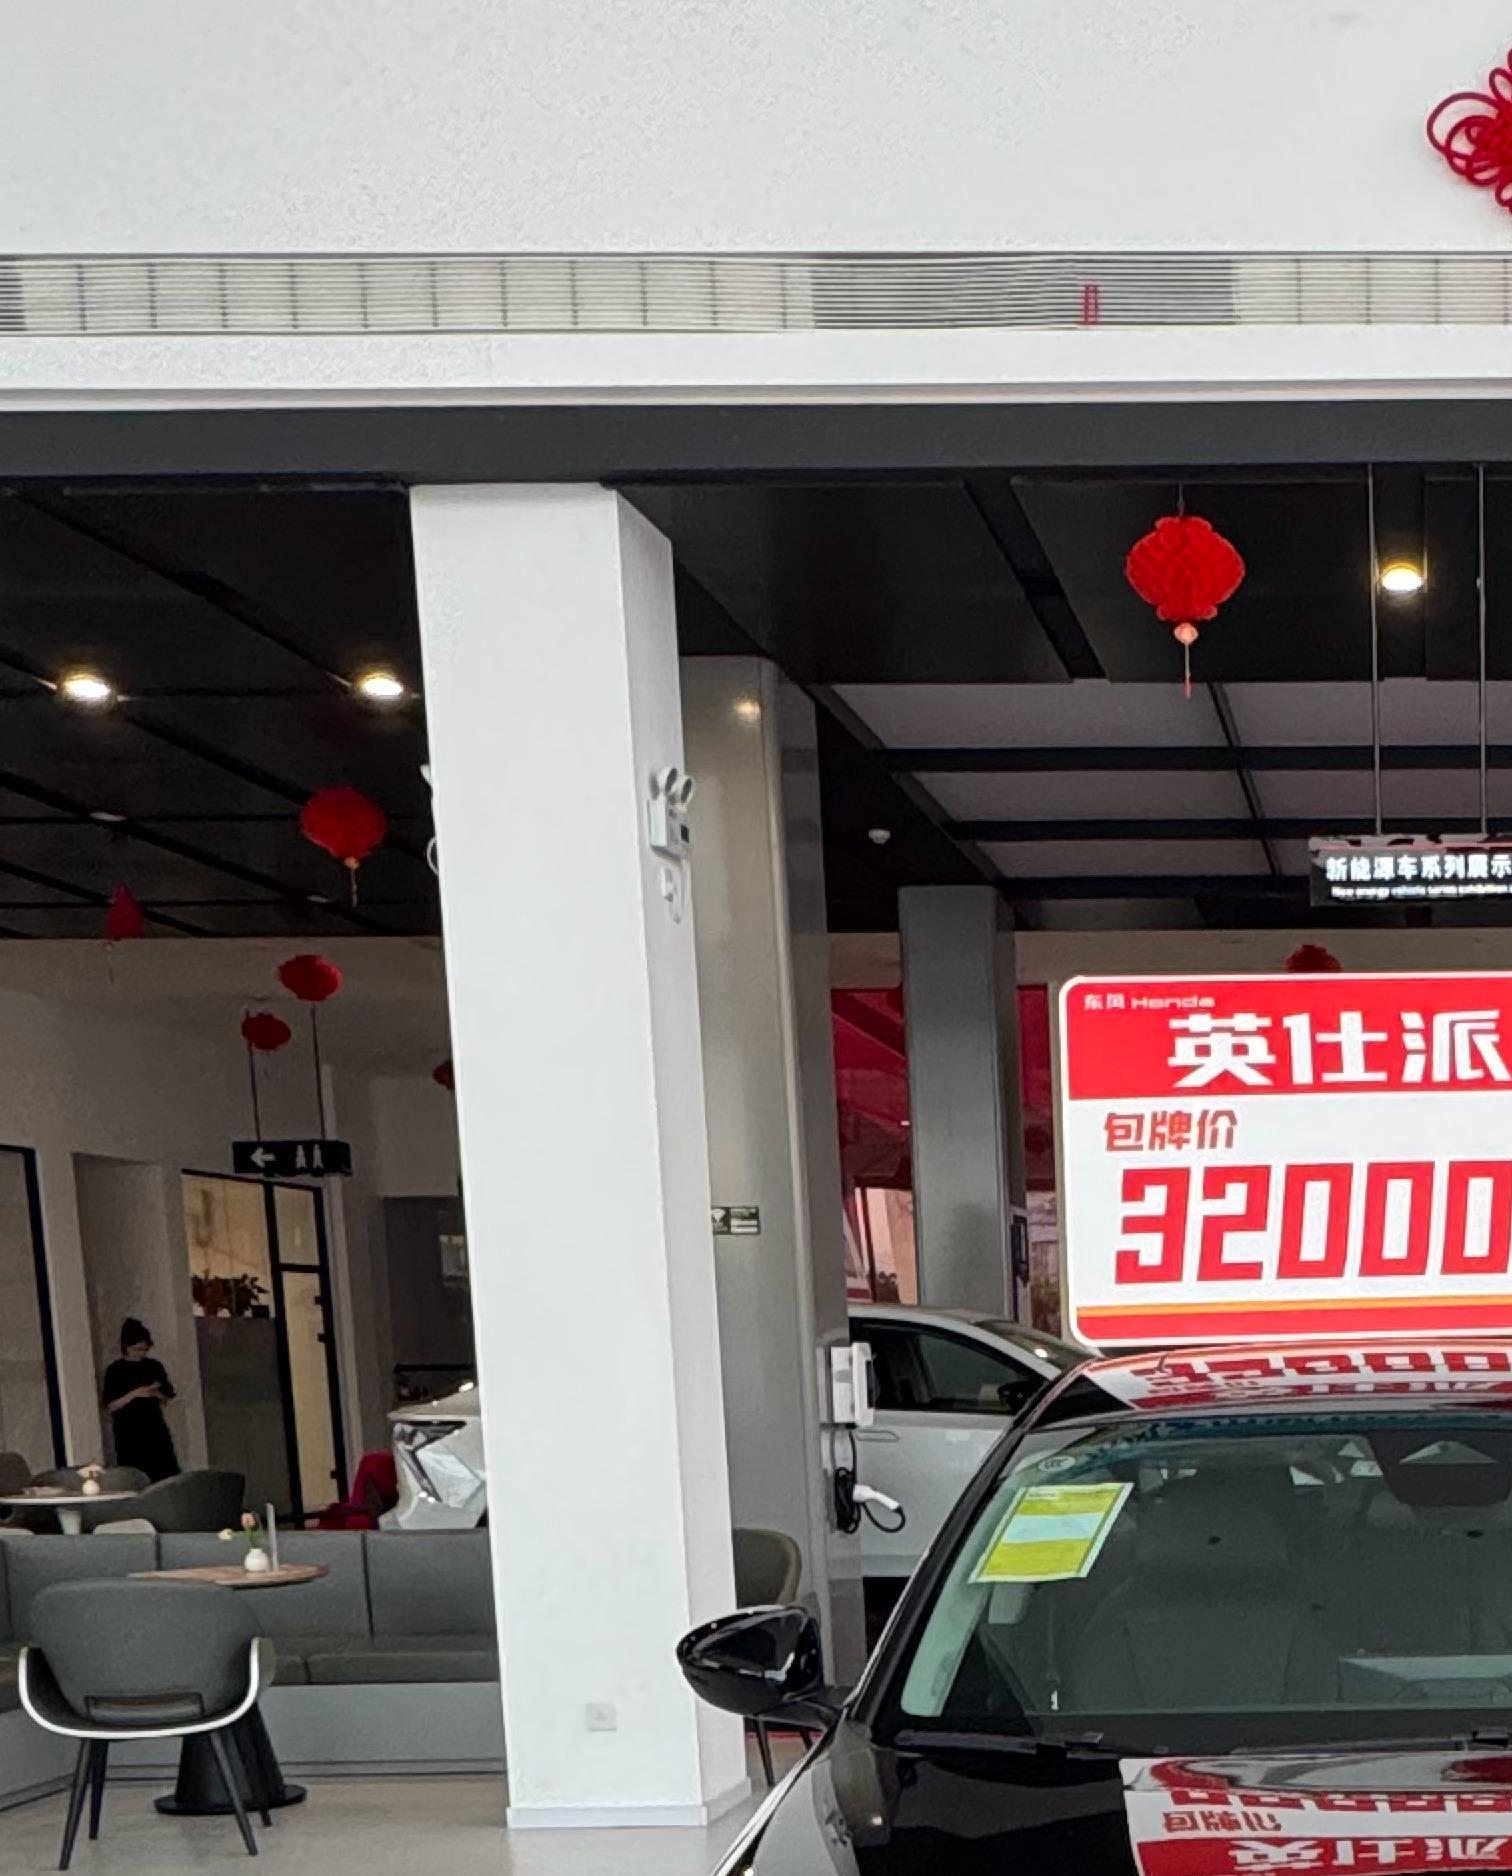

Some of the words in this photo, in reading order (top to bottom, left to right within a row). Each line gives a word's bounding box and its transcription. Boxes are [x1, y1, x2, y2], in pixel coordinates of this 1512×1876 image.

[1131, 996, 1216, 1009] Honda
[1167, 1010, 1512, 1088] 英仕派
[1104, 1110, 1238, 1151] 包牌价
